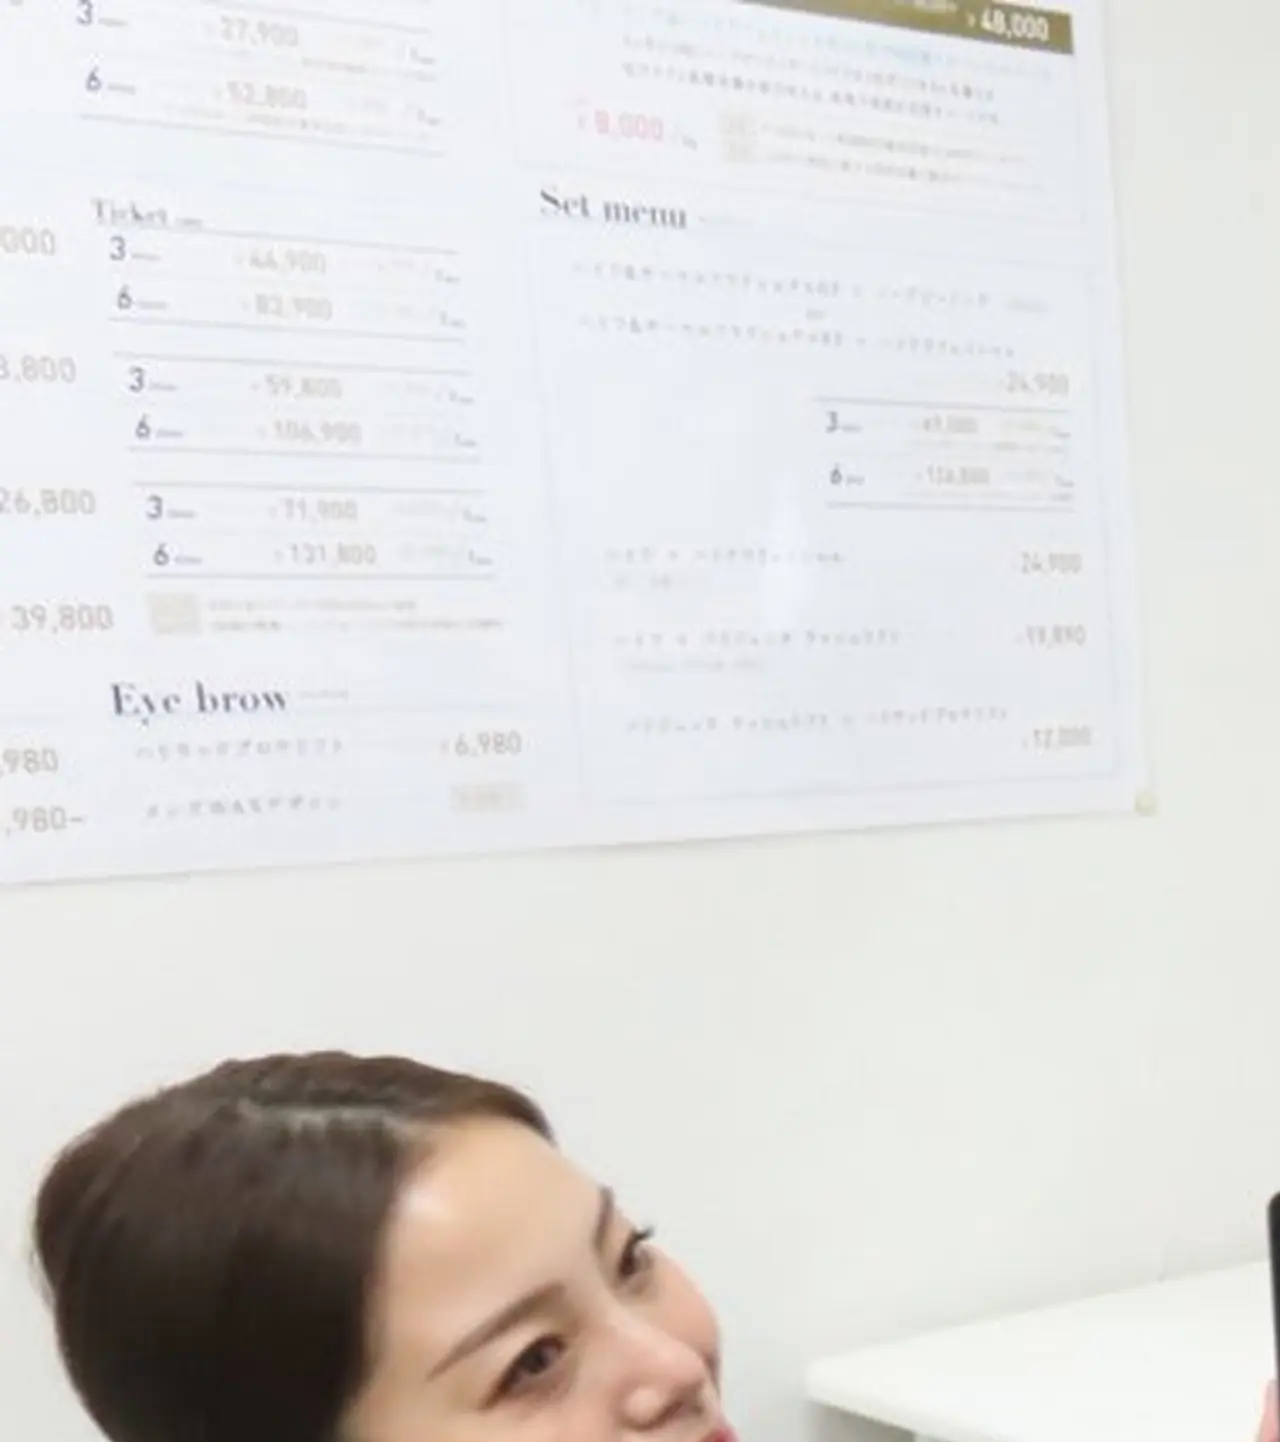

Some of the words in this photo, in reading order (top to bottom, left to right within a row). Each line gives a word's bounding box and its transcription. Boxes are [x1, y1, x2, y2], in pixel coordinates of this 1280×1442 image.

[85, 66, 102, 92] 6
[540, 186, 589, 219] Set
[602, 201, 687, 230] menu
[109, 236, 126, 262] 3
[116, 283, 133, 310] 6
[128, 365, 146, 393] 3
[134, 412, 151, 441] 6
[145, 494, 164, 521] 3
[152, 543, 170, 567] 6
[10, 603, 115, 635] 39,800
[109, 682, 182, 726] Eye
[194, 680, 287, 714] brow
